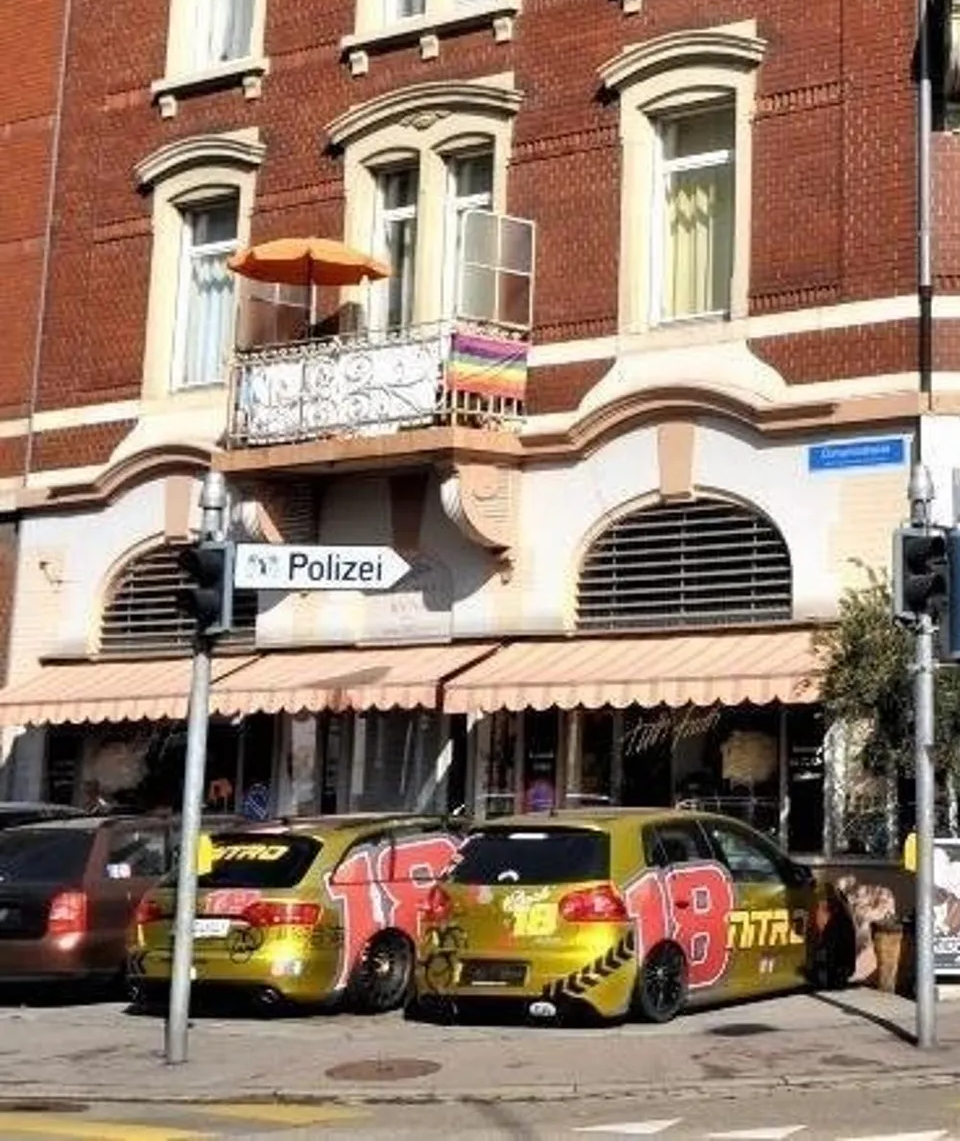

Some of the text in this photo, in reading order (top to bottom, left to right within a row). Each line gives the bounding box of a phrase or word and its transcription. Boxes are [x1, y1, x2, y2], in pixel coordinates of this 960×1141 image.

[288, 553, 383, 581] Polizei
[212, 845, 289, 860] ITRO
[513, 903, 558, 936] 18
[625, 863, 734, 989] 18
